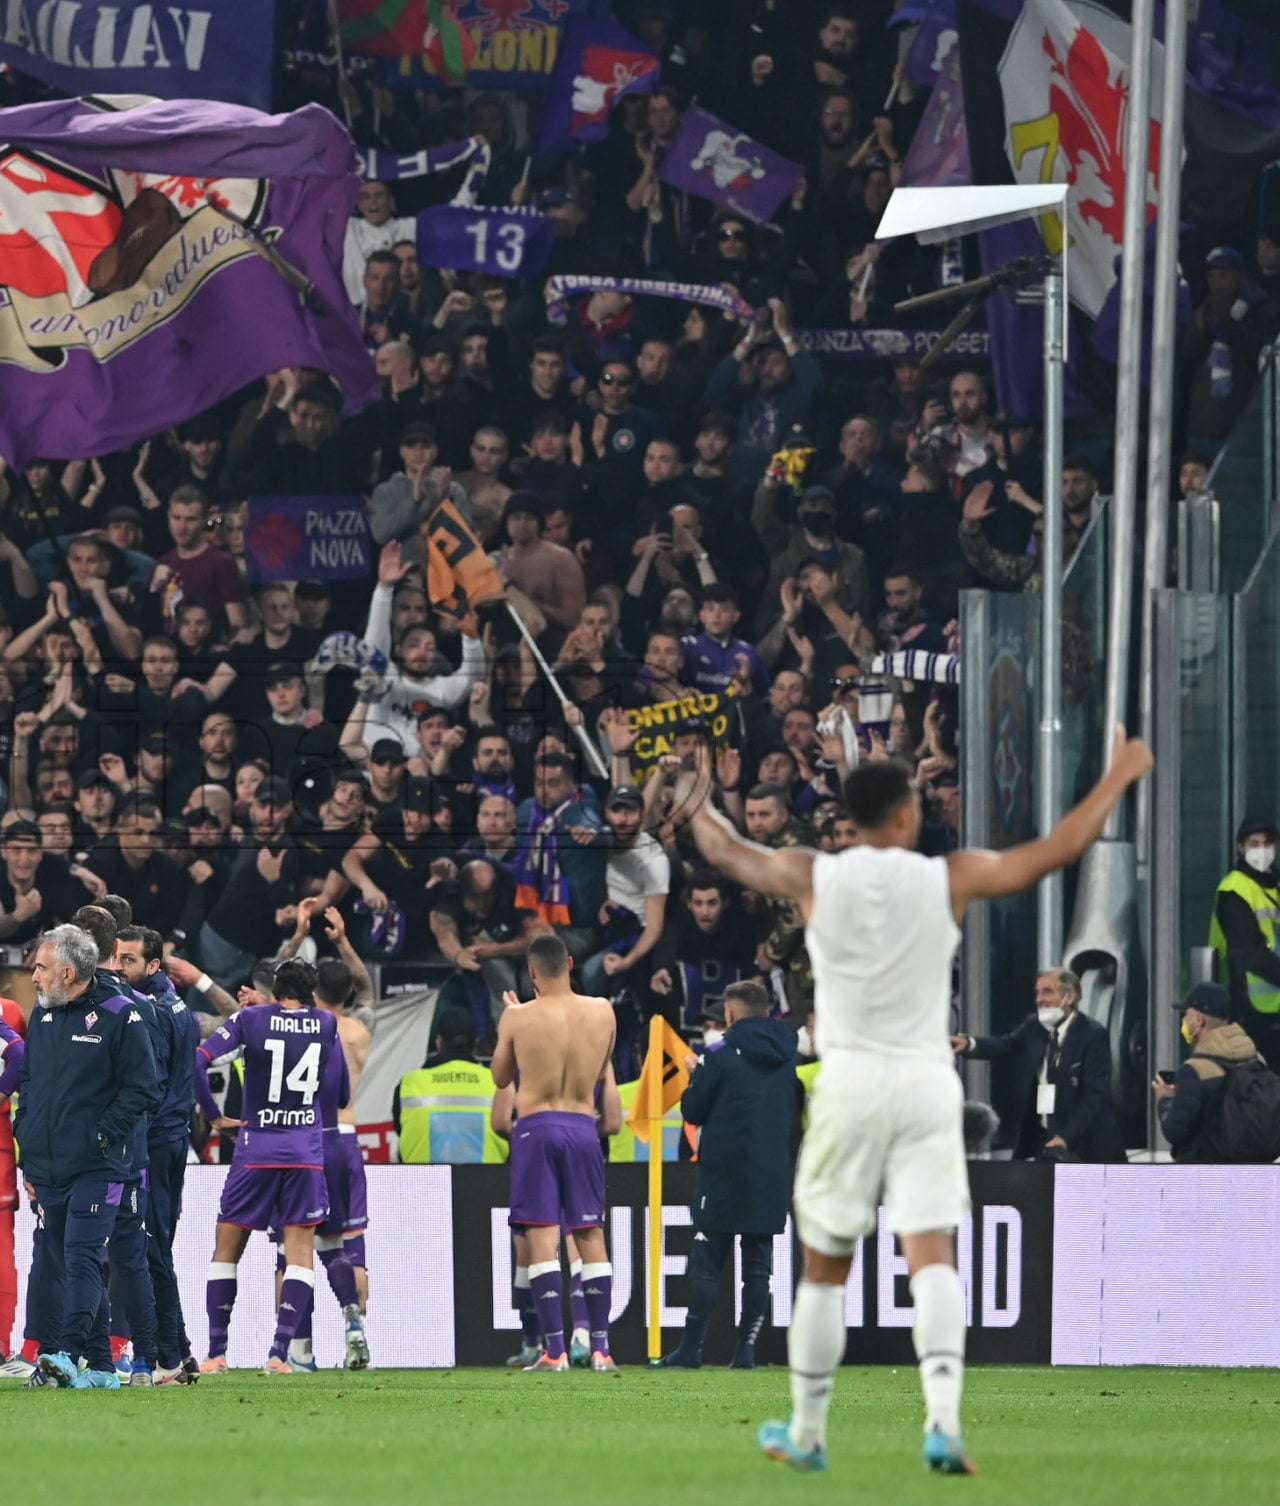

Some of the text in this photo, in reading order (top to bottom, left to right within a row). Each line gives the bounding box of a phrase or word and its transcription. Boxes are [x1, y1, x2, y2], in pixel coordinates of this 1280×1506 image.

[466, 219, 526, 271] 13
[311, 538, 365, 568] NOVA
[615, 693, 719, 731] ONTRO
[270, 1015, 320, 1034] MALEH
[264, 1038, 322, 1105] 14
[432, 1071, 480, 1084] JUVENTUS
[257, 1108, 315, 1128] prima
